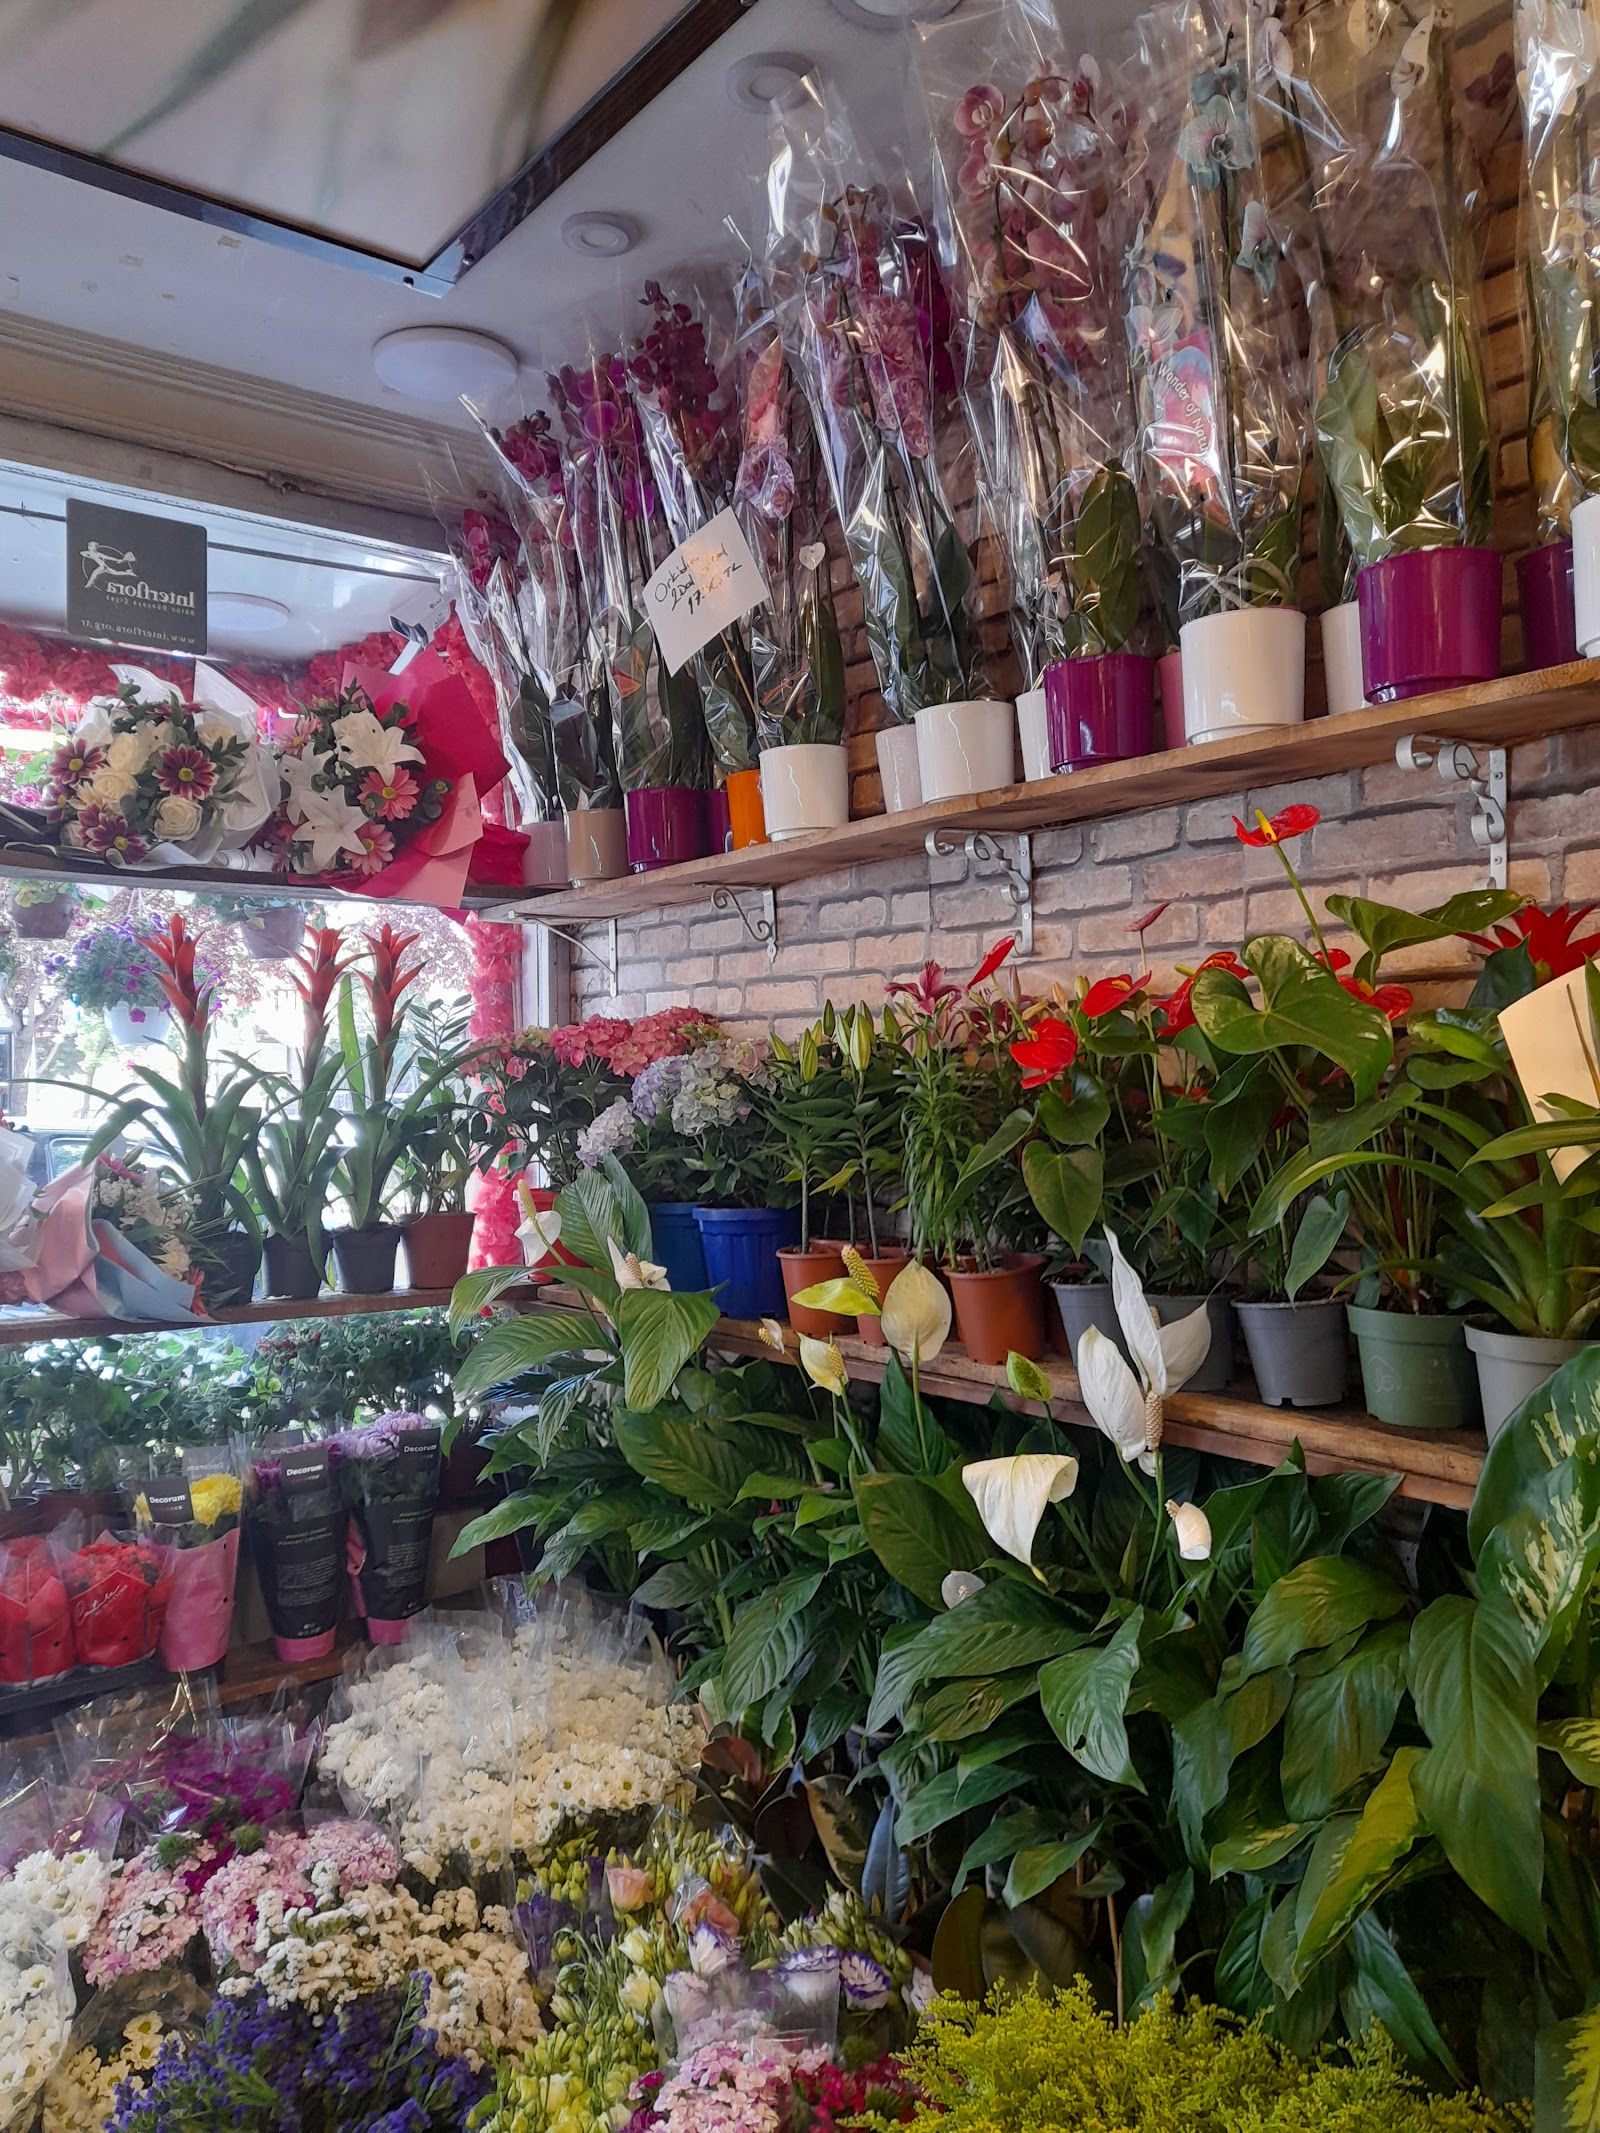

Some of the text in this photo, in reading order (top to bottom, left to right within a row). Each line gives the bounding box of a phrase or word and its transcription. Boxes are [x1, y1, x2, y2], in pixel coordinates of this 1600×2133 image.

[1158, 362, 1209, 453] Wonder of Natu
[723, 562, 743, 578] TL
[403, 1443, 437, 1453] Decorum
[286, 1463, 323, 1477] Decorum
[149, 1494, 186, 1504] Decorum
